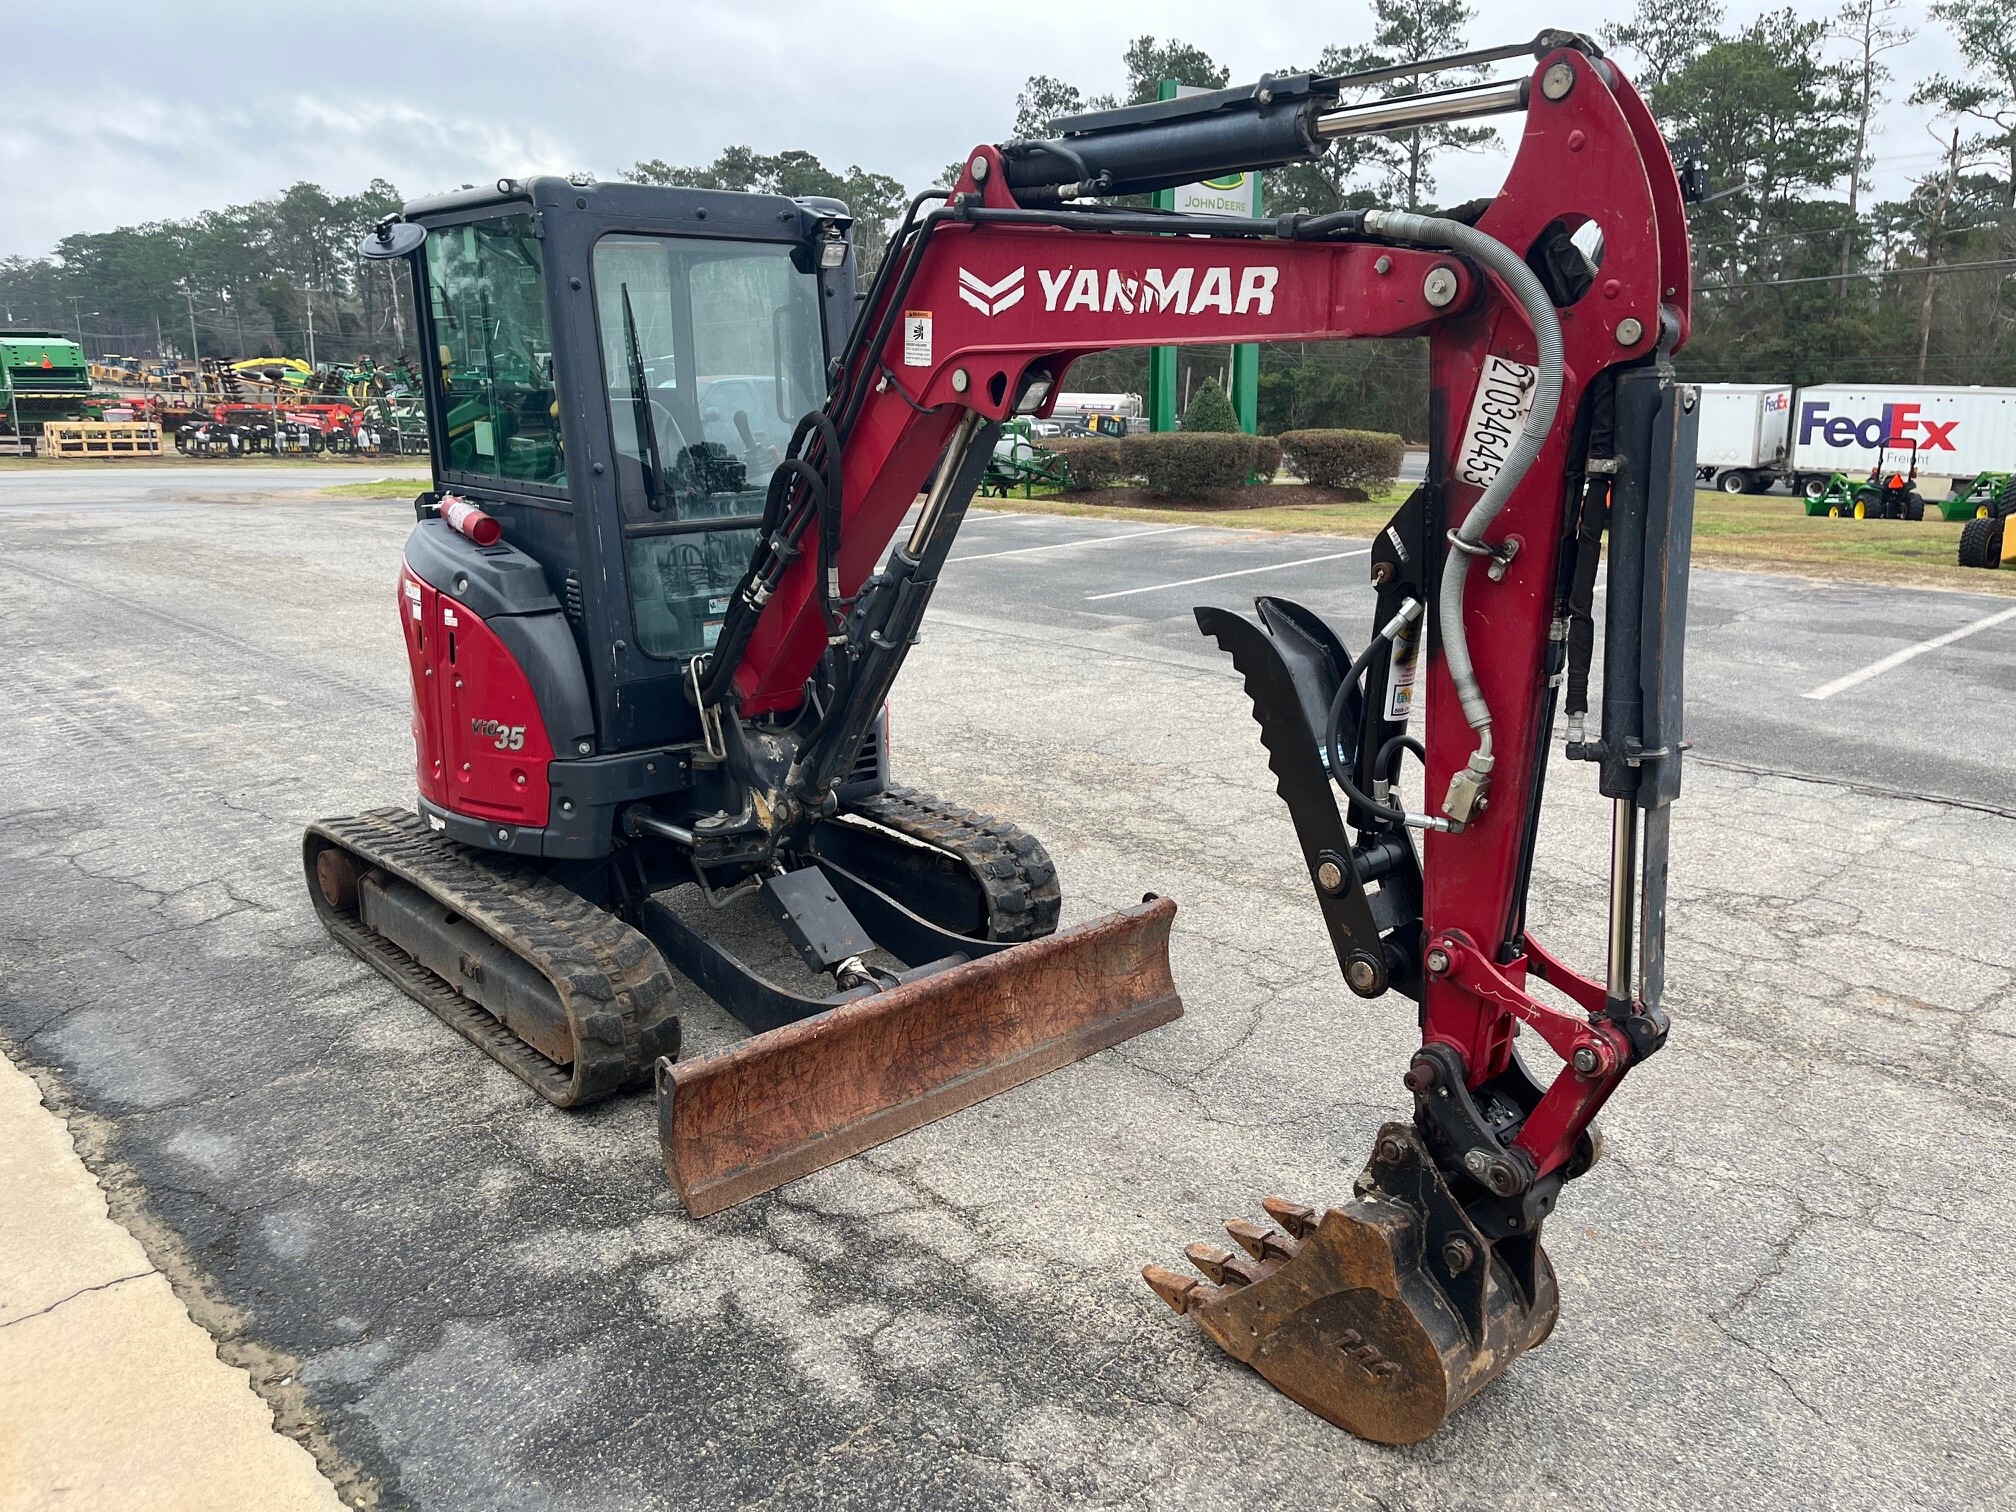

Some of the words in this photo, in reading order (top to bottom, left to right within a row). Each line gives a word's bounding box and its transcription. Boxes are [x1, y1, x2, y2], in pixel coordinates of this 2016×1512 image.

[1185, 195, 1215, 209] JOHN
[1217, 198, 1246, 212] DEERE
[1037, 265, 1278, 315] YANMAR
[1765, 394, 1788, 412] FedEx
[1463, 359, 1535, 487] 210346453
[1799, 401, 1960, 451] FedEx
[1886, 451, 1930, 465] Freiht
